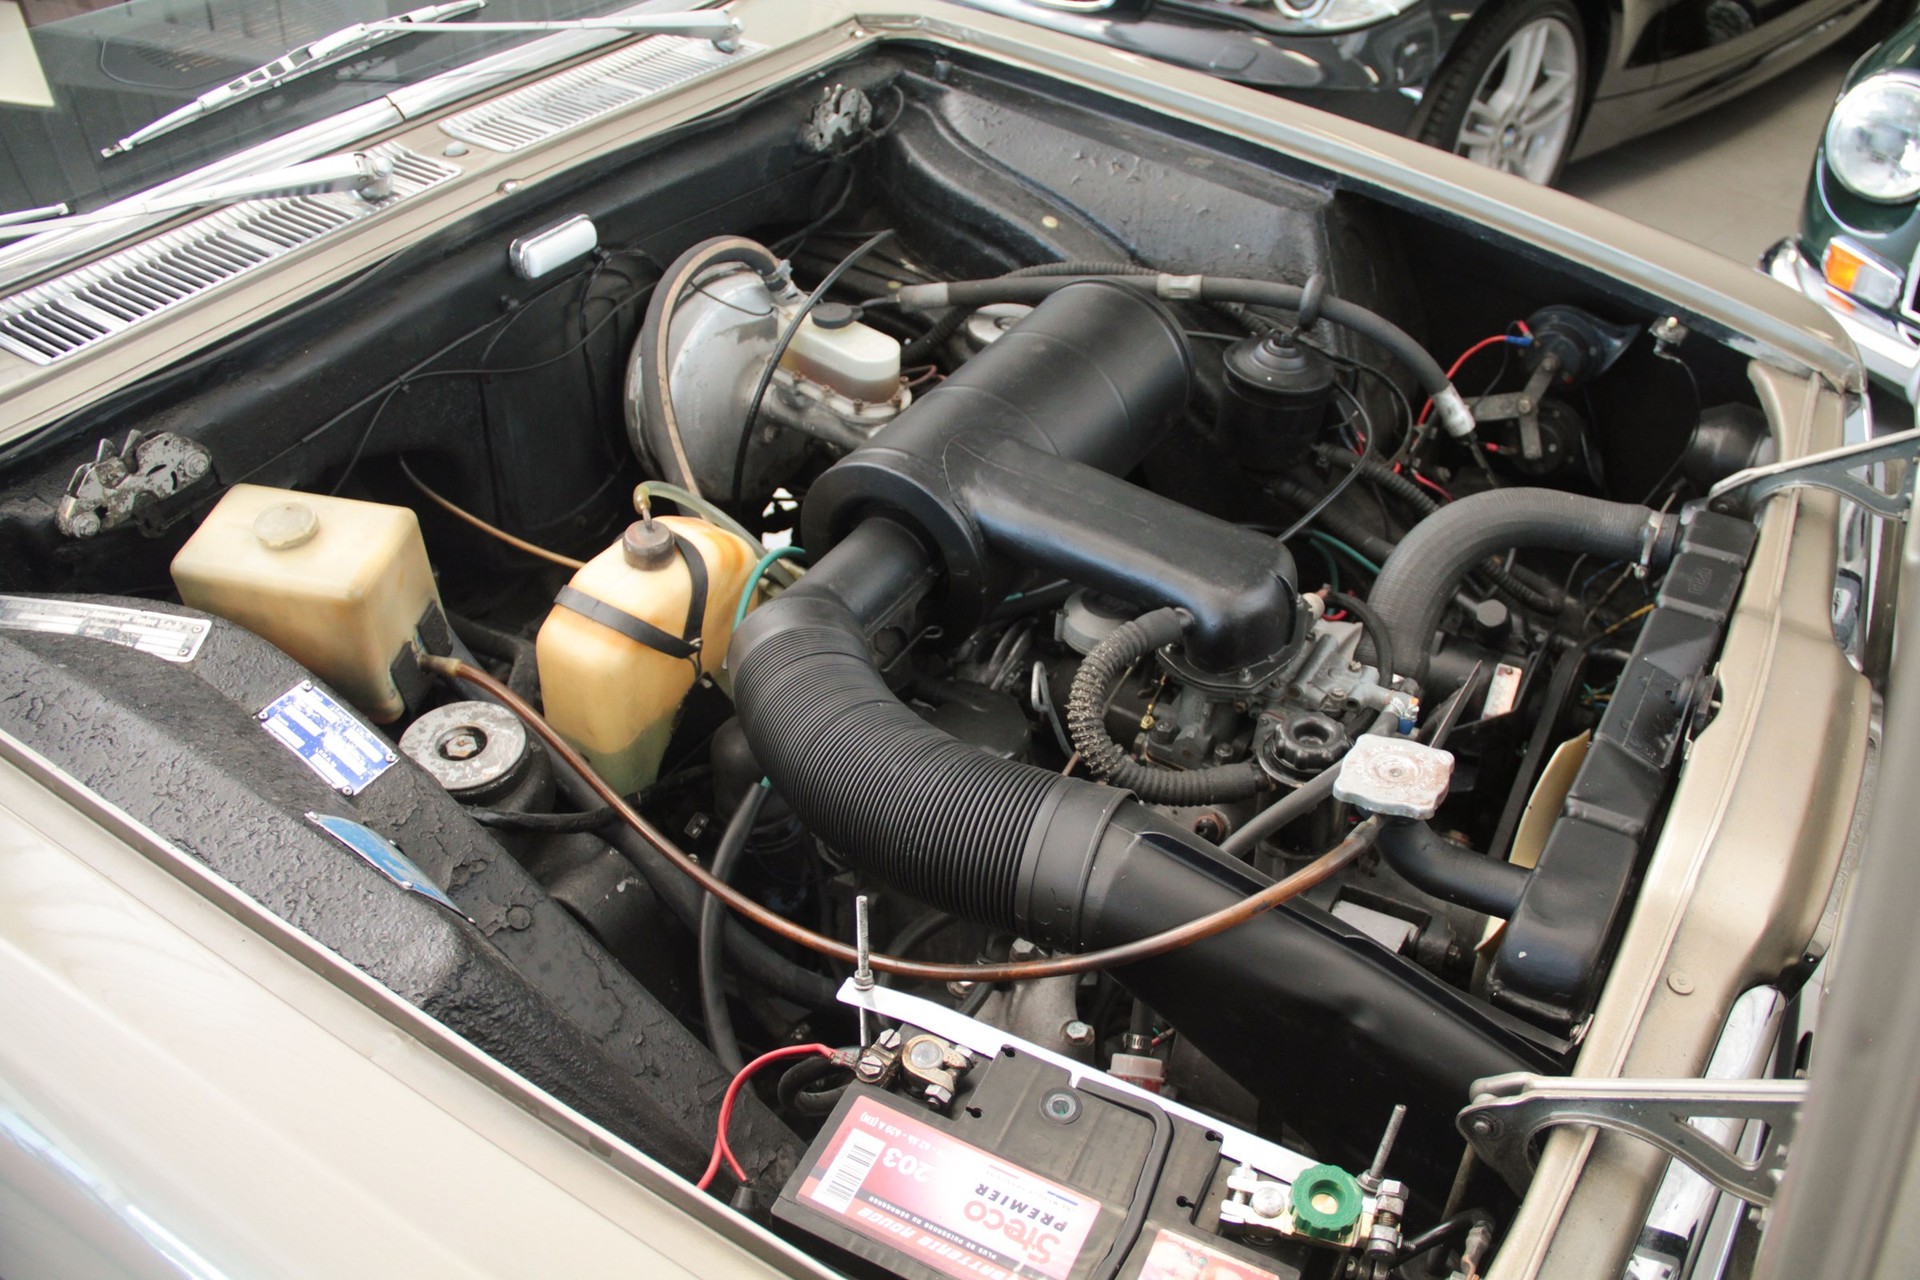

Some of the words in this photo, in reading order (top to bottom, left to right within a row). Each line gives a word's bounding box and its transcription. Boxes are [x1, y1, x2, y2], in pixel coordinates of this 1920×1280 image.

[882, 1147, 934, 1183] 203
[857, 1206, 917, 1238] ROUGE
[911, 1215, 922, 1224] AU
[974, 1183, 1068, 1232] PREMIER
[923, 1220, 964, 1244] PUISSANCE
[963, 1200, 1061, 1265] Steco
[977, 1246, 997, 1260] PLUS
